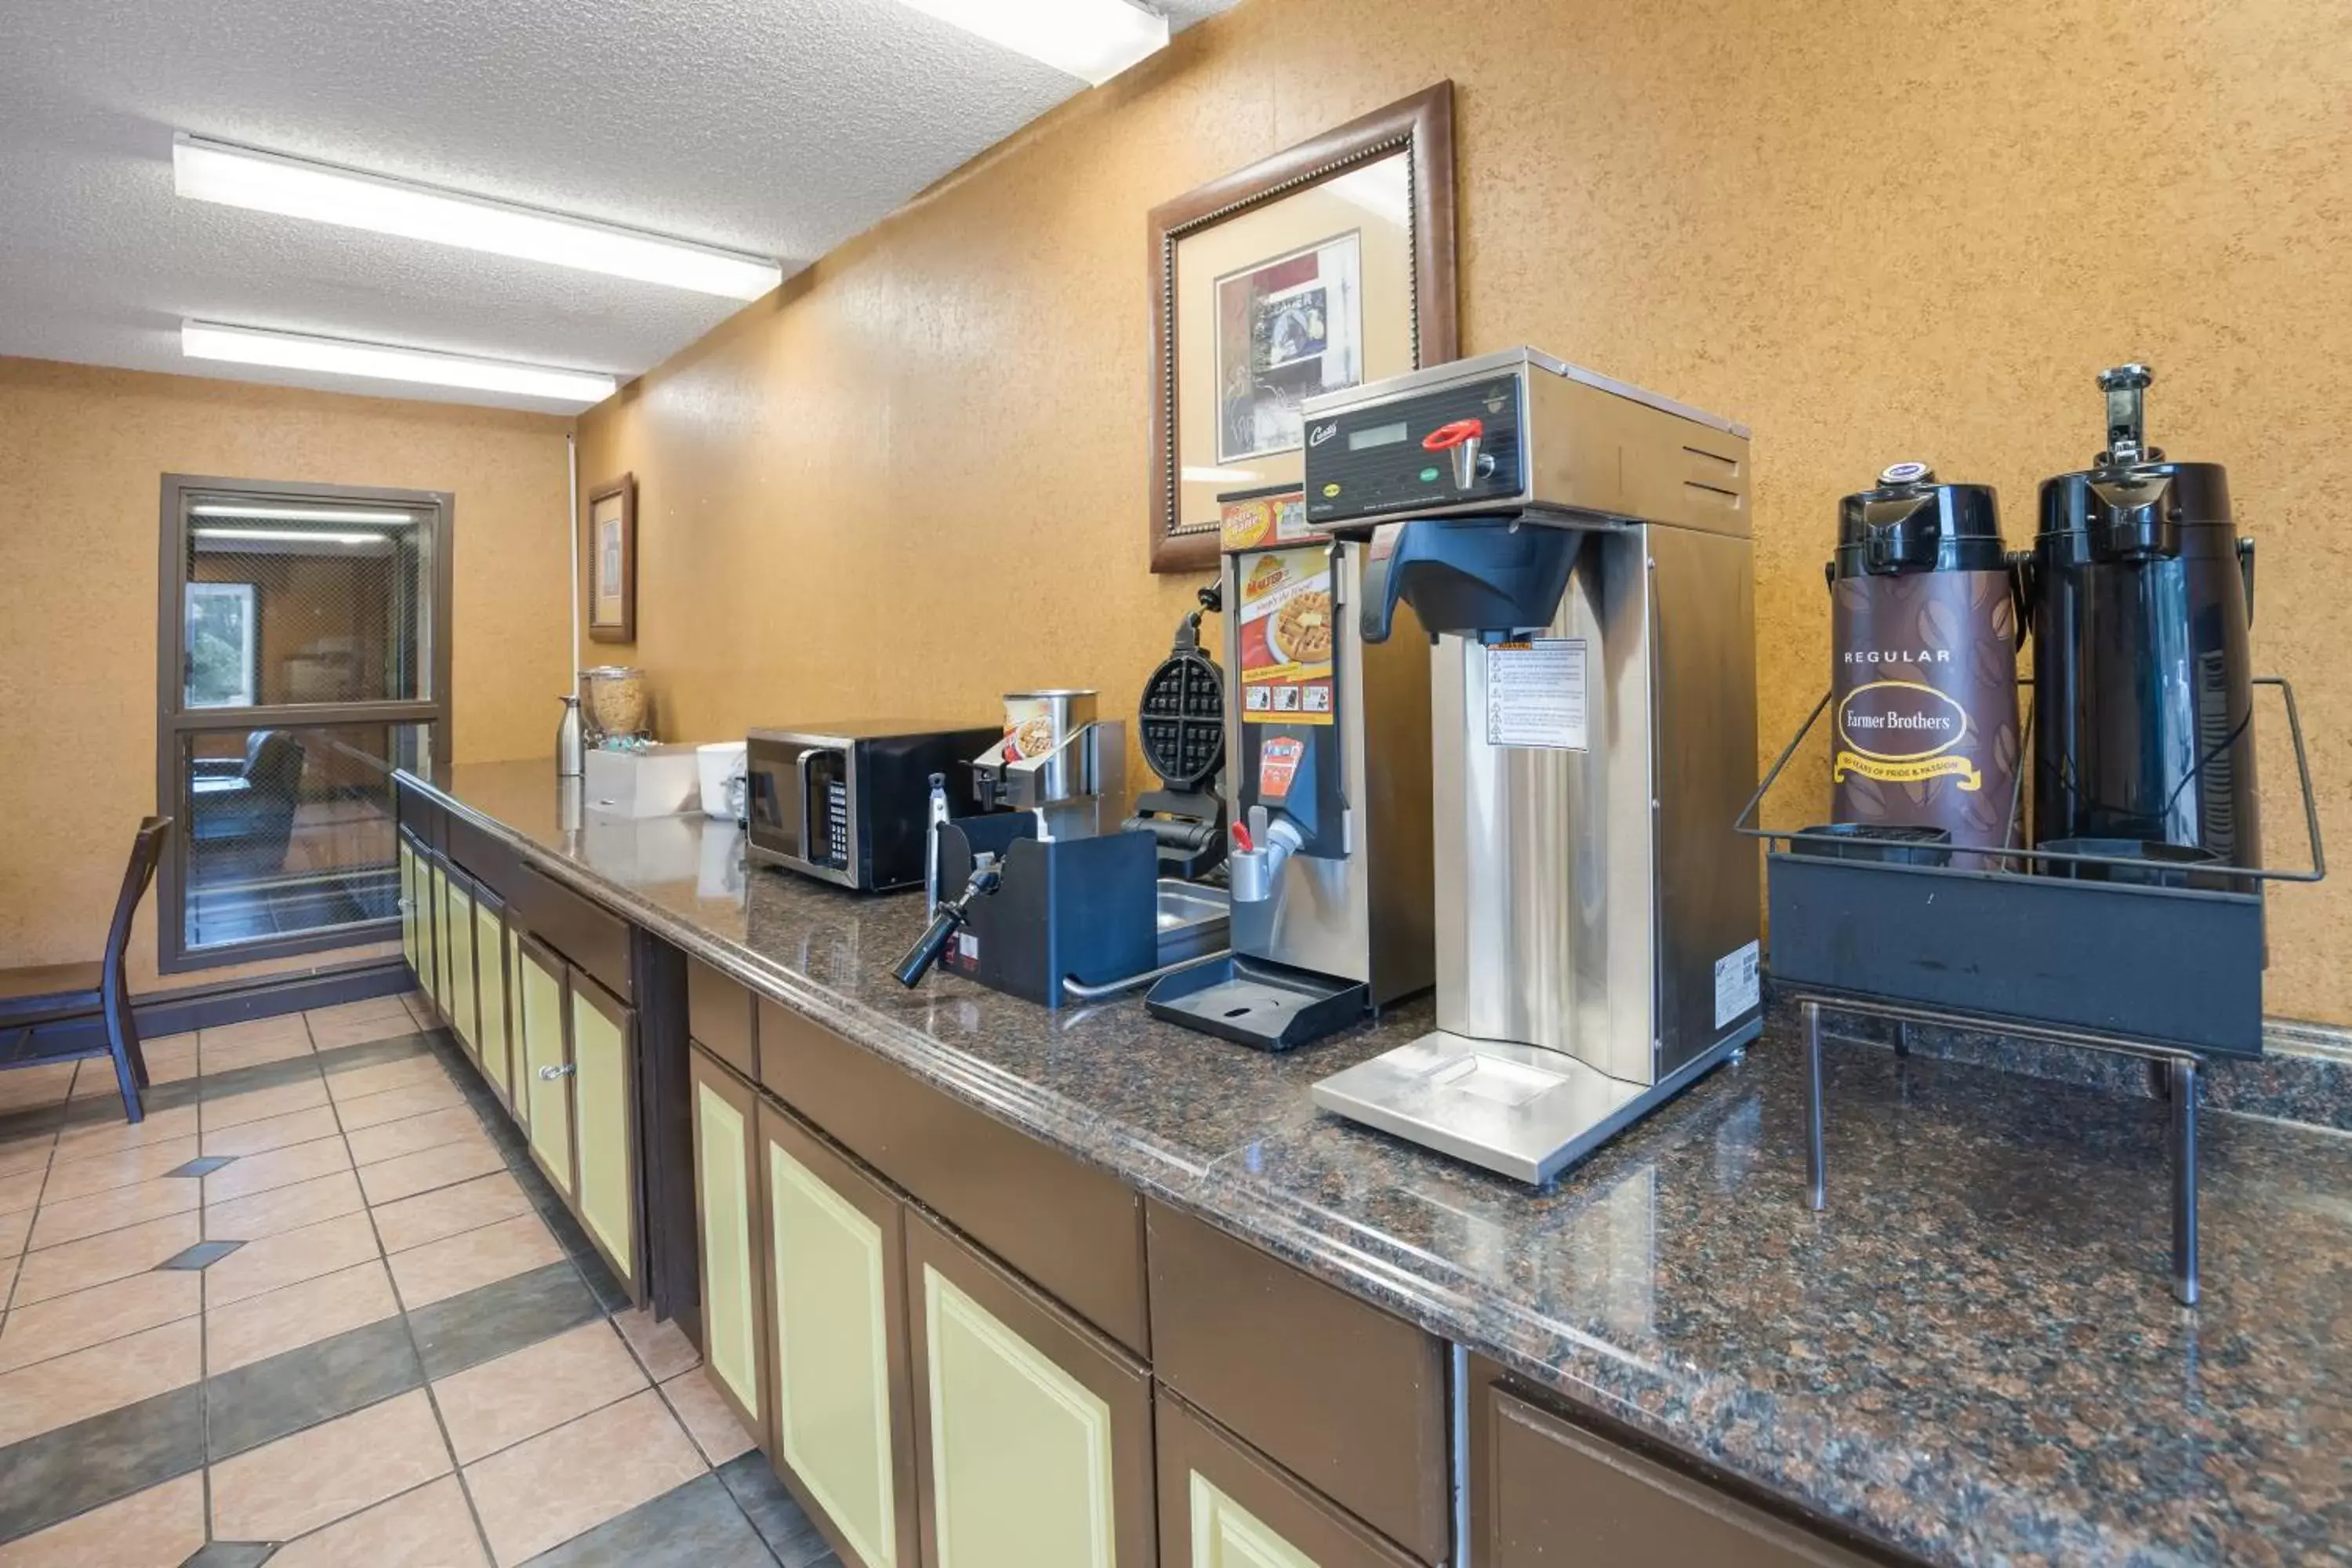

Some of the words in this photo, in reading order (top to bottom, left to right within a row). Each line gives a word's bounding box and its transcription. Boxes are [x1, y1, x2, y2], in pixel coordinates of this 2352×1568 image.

[1844, 650, 1950, 663] REGULAR
[1847, 710, 1885, 729] Farmer
[1887, 711, 1950, 729] Brothers
[1873, 767, 1883, 776] OF
[1886, 768, 1911, 777] PRIDE
[1920, 761, 1958, 775] PASSION
